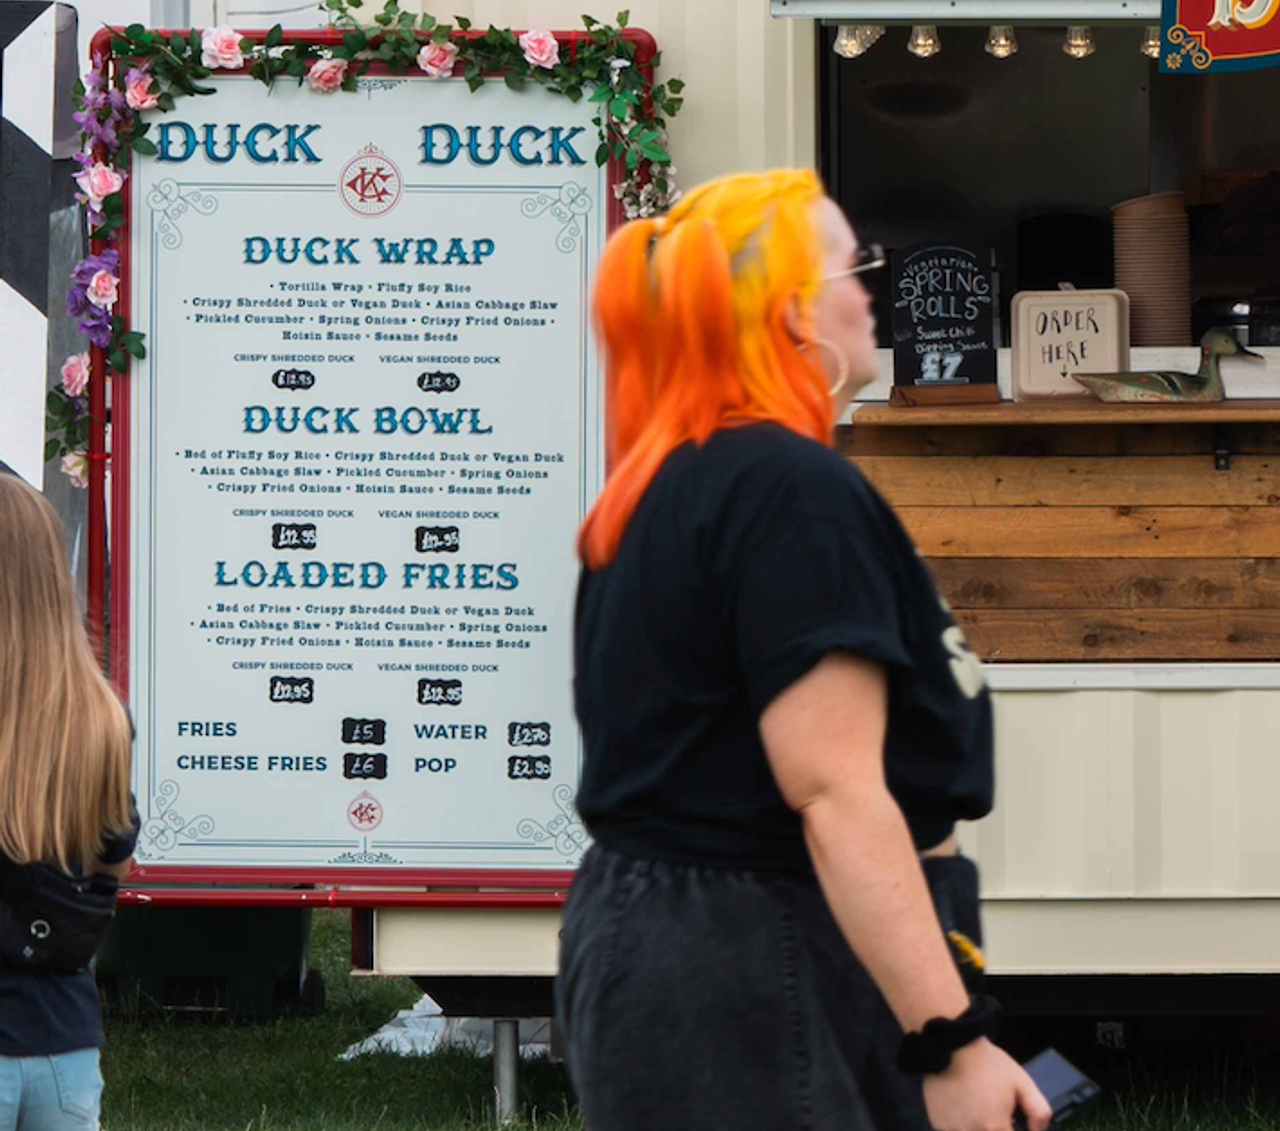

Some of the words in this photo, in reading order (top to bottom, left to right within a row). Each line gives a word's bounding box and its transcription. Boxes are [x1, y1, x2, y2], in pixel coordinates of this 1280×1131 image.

[157, 121, 322, 164] DUCK
[418, 124, 587, 165] DUCK
[243, 237, 360, 264] DUCK
[372, 238, 494, 265] WRAP
[908, 257, 974, 277] Vegetarian
[278, 281, 326, 291] Tortilla
[331, 282, 363, 293] Wrap
[377, 282, 413, 293] Fluffy
[418, 283, 439, 294] Soy
[444, 283, 471, 292] Rice
[898, 268, 990, 301] SPRING
[192, 297, 231, 308] Crispy
[236, 297, 292, 307] Shredded
[297, 298, 327, 307] Duck
[350, 298, 386, 309] Vegan
[391, 299, 421, 308] Duck
[435, 300, 470, 309] Asian
[475, 300, 525, 311] Cabbage
[529, 300, 557, 309] Slaw
[910, 296, 980, 323] ROLLS
[1036, 307, 1099, 336] ORDER
[271, 354, 325, 362] SHREDDED
[378, 355, 413, 363] VEGAN
[416, 355, 470, 363] SHREDDED
[473, 356, 500, 364] DUCK
[1041, 339, 1088, 366] HERE
[921, 352, 964, 380] £7
[243, 406, 359, 433] DUCK
[373, 407, 492, 434] BOWL
[184, 449, 206, 458] Bed
[210, 450, 222, 459] of
[227, 450, 262, 460] Fluffy
[268, 450, 289, 461] Soy
[294, 450, 320, 460] Rice
[334, 451, 374, 462] Crispy
[379, 451, 434, 460] Shredded
[440, 452, 469, 461] Duck
[492, 452, 529, 463] Vegan
[534, 452, 564, 462] Duck
[215, 561, 387, 588] LOADED
[402, 563, 519, 590] FRIES
[216, 603, 238, 612] Bed
[243, 604, 254, 613] of
[259, 603, 290, 613] Fries
[304, 604, 344, 615] Crispy
[349, 605, 405, 614] Shredded
[410, 605, 440, 615] Duck
[445, 607, 458, 615] or
[463, 605, 499, 617] Vegan
[504, 606, 534, 616] Duck
[178, 722, 236, 736] FRIES
[352, 724, 374, 741] £5
[413, 724, 487, 739] WATER
[176, 755, 258, 770] CHEESE
[268, 756, 327, 770] FRIES
[351, 757, 375, 774] £6
[414, 758, 456, 772] POP
